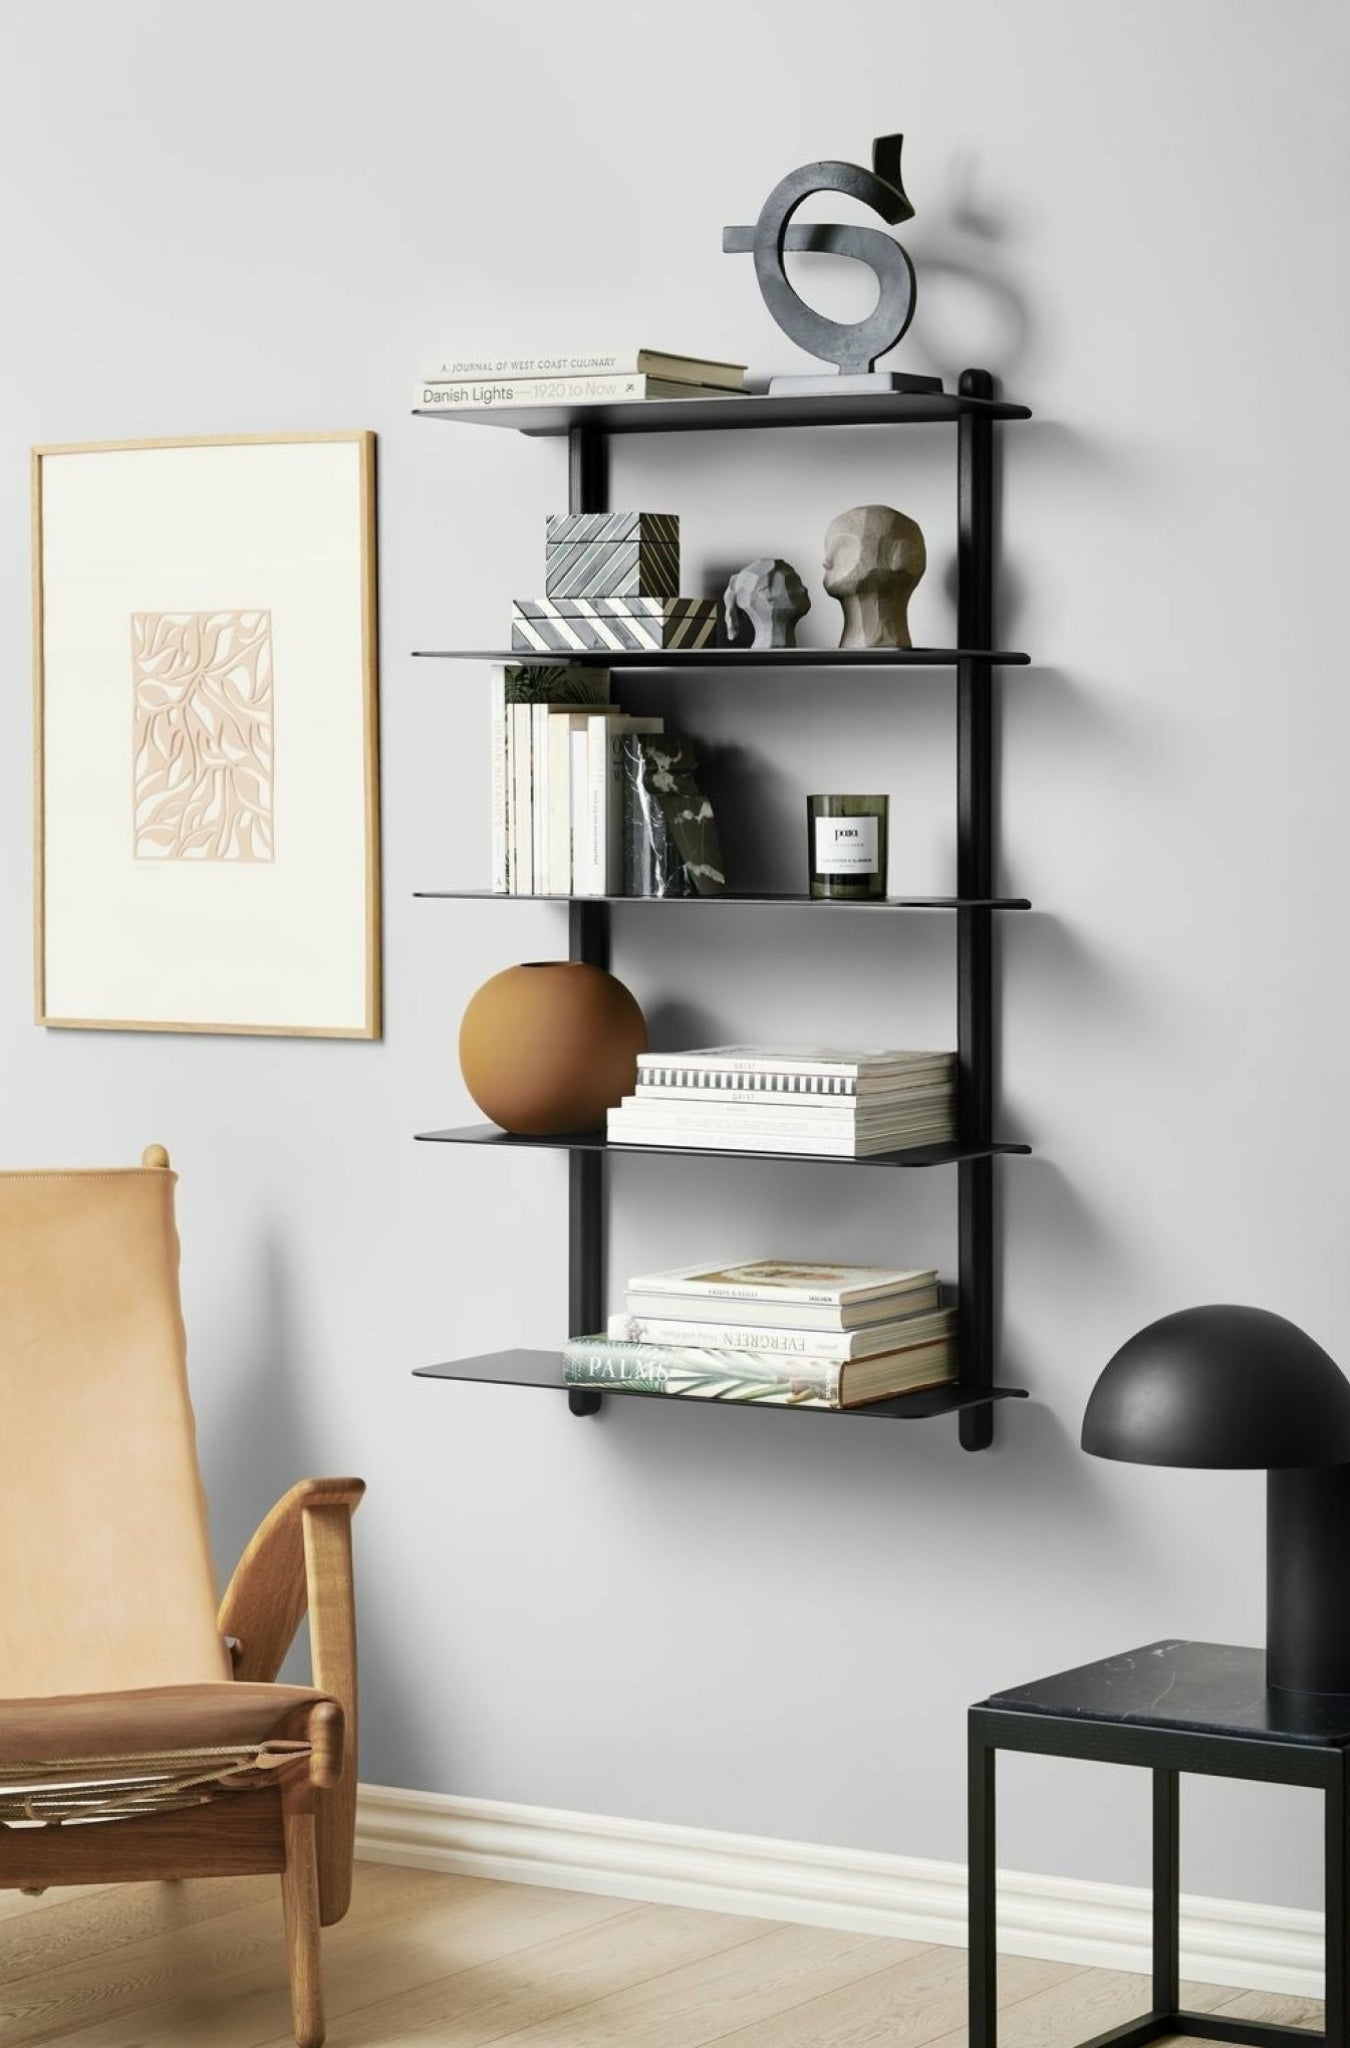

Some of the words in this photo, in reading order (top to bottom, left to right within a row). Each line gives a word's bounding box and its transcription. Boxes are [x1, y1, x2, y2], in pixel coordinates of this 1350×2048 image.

[452, 362, 493, 373] JOURNAL
[495, 362, 507, 371] OF
[511, 360, 534, 371] WEST
[537, 359, 567, 369] COAST
[570, 357, 616, 368] CULINARY
[423, 386, 469, 404] Danish
[473, 385, 513, 405] Lights
[568, 384, 583, 397] to
[585, 382, 617, 396] Now
[724, 1333, 806, 1352] EVERGREEN
[587, 1356, 669, 1382] PALMS
